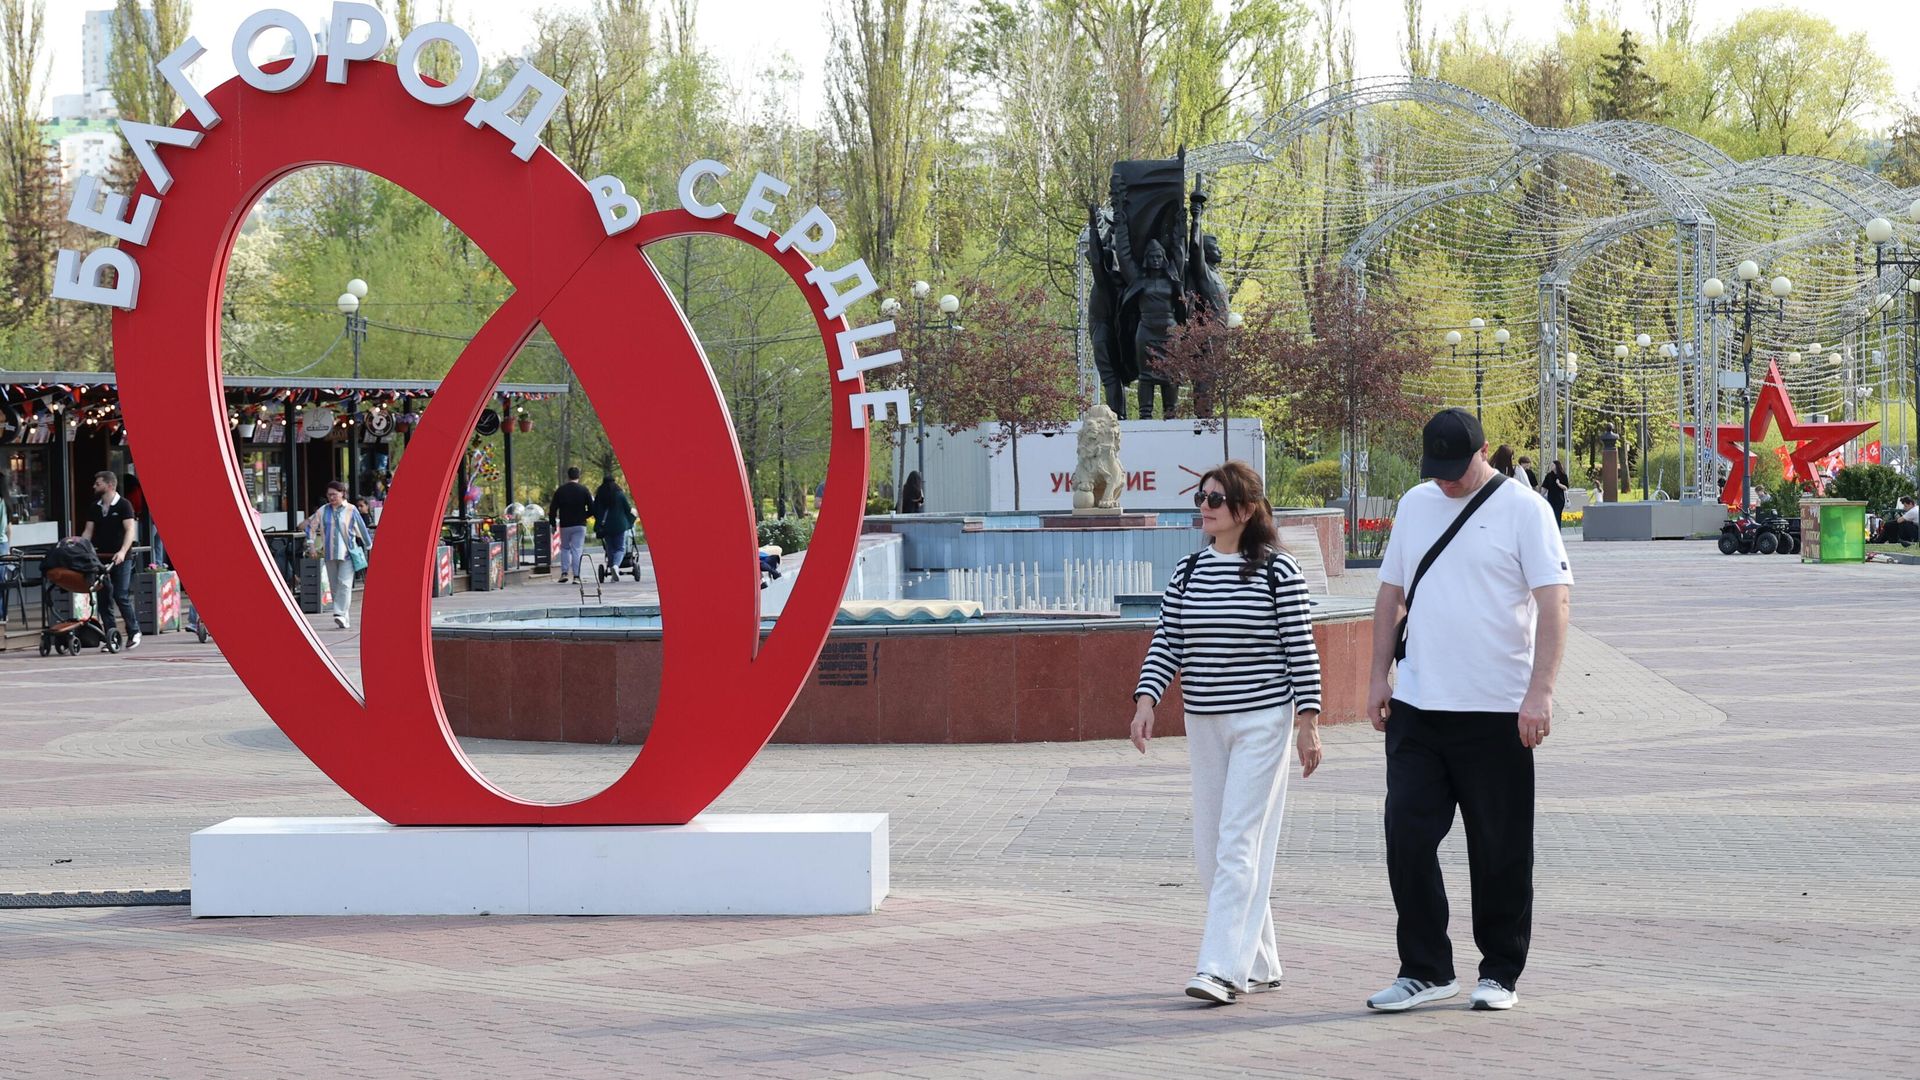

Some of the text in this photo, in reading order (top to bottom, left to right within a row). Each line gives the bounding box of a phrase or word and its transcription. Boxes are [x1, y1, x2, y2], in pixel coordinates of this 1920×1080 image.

[51, 0, 911, 429] БЕЛГОРОД В СЕРДЦЕ
